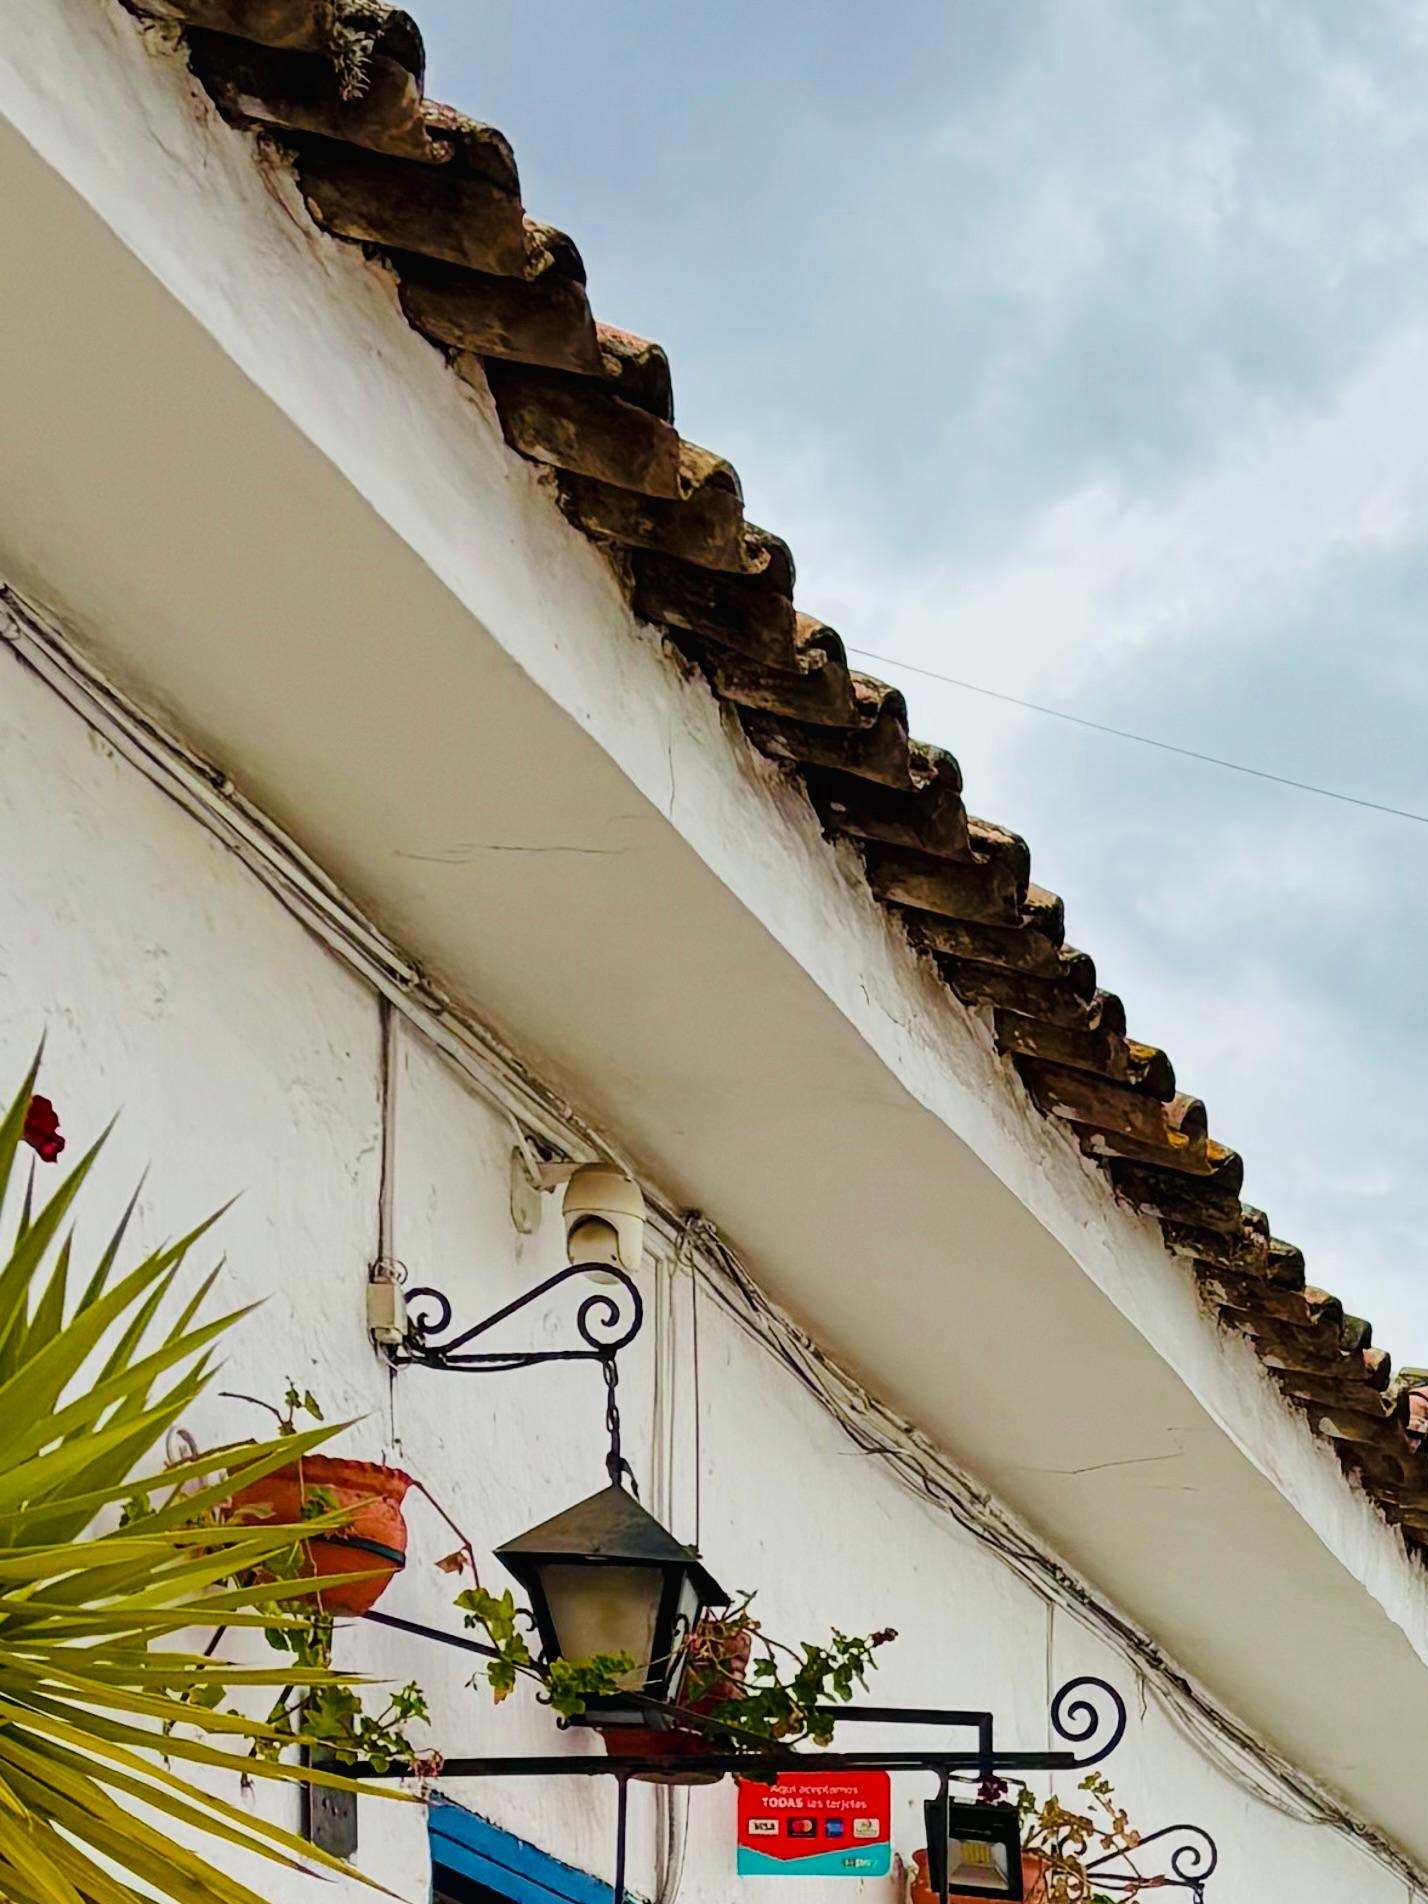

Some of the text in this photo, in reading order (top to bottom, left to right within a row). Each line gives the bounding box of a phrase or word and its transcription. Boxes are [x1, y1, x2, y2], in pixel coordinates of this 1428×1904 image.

[799, 1785, 858, 1795] aceptamos
[762, 1797, 867, 1810] TODAS las tarjetas
